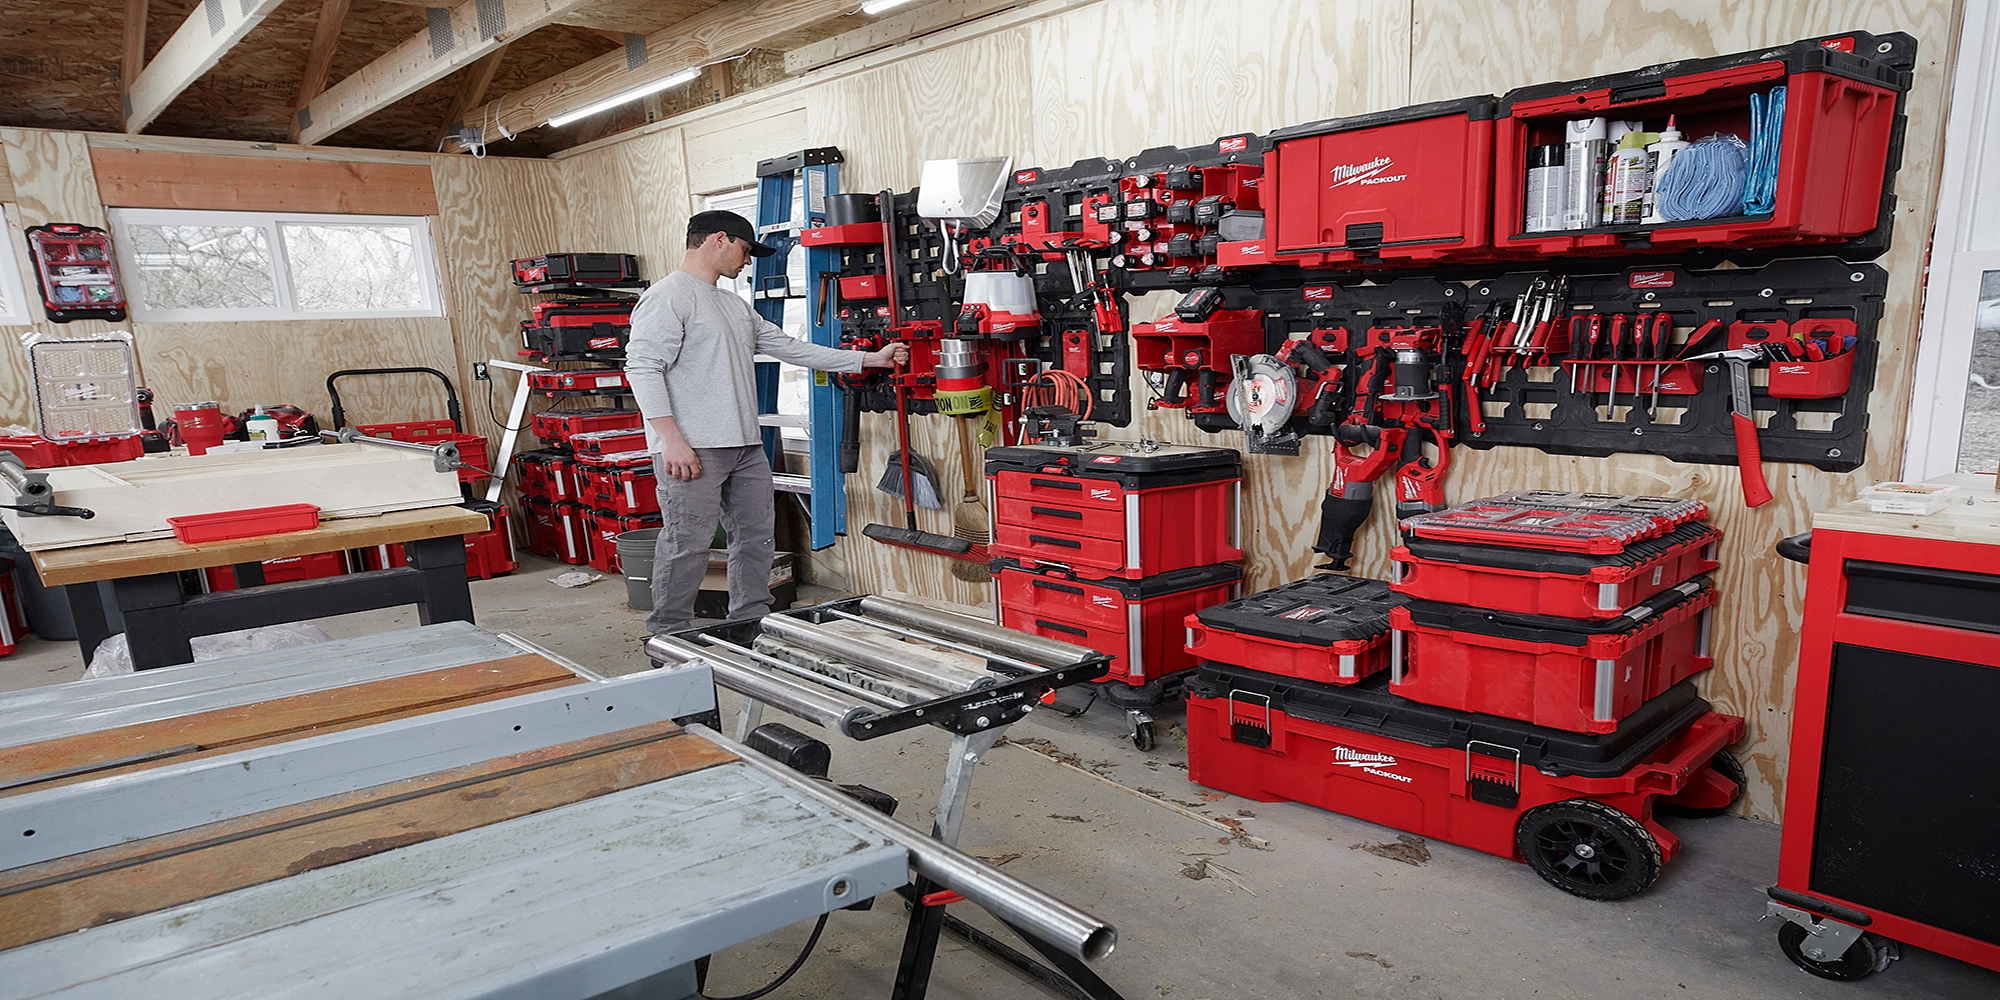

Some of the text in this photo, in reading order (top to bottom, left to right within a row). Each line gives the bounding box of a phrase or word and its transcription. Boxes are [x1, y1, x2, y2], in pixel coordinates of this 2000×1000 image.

[1330, 157, 1391, 182] Milwaukee
[1360, 174, 1407, 185] PACKOUT
[1331, 745, 1395, 764] Milwaukee
[1363, 767, 1412, 783] PACKOUT
